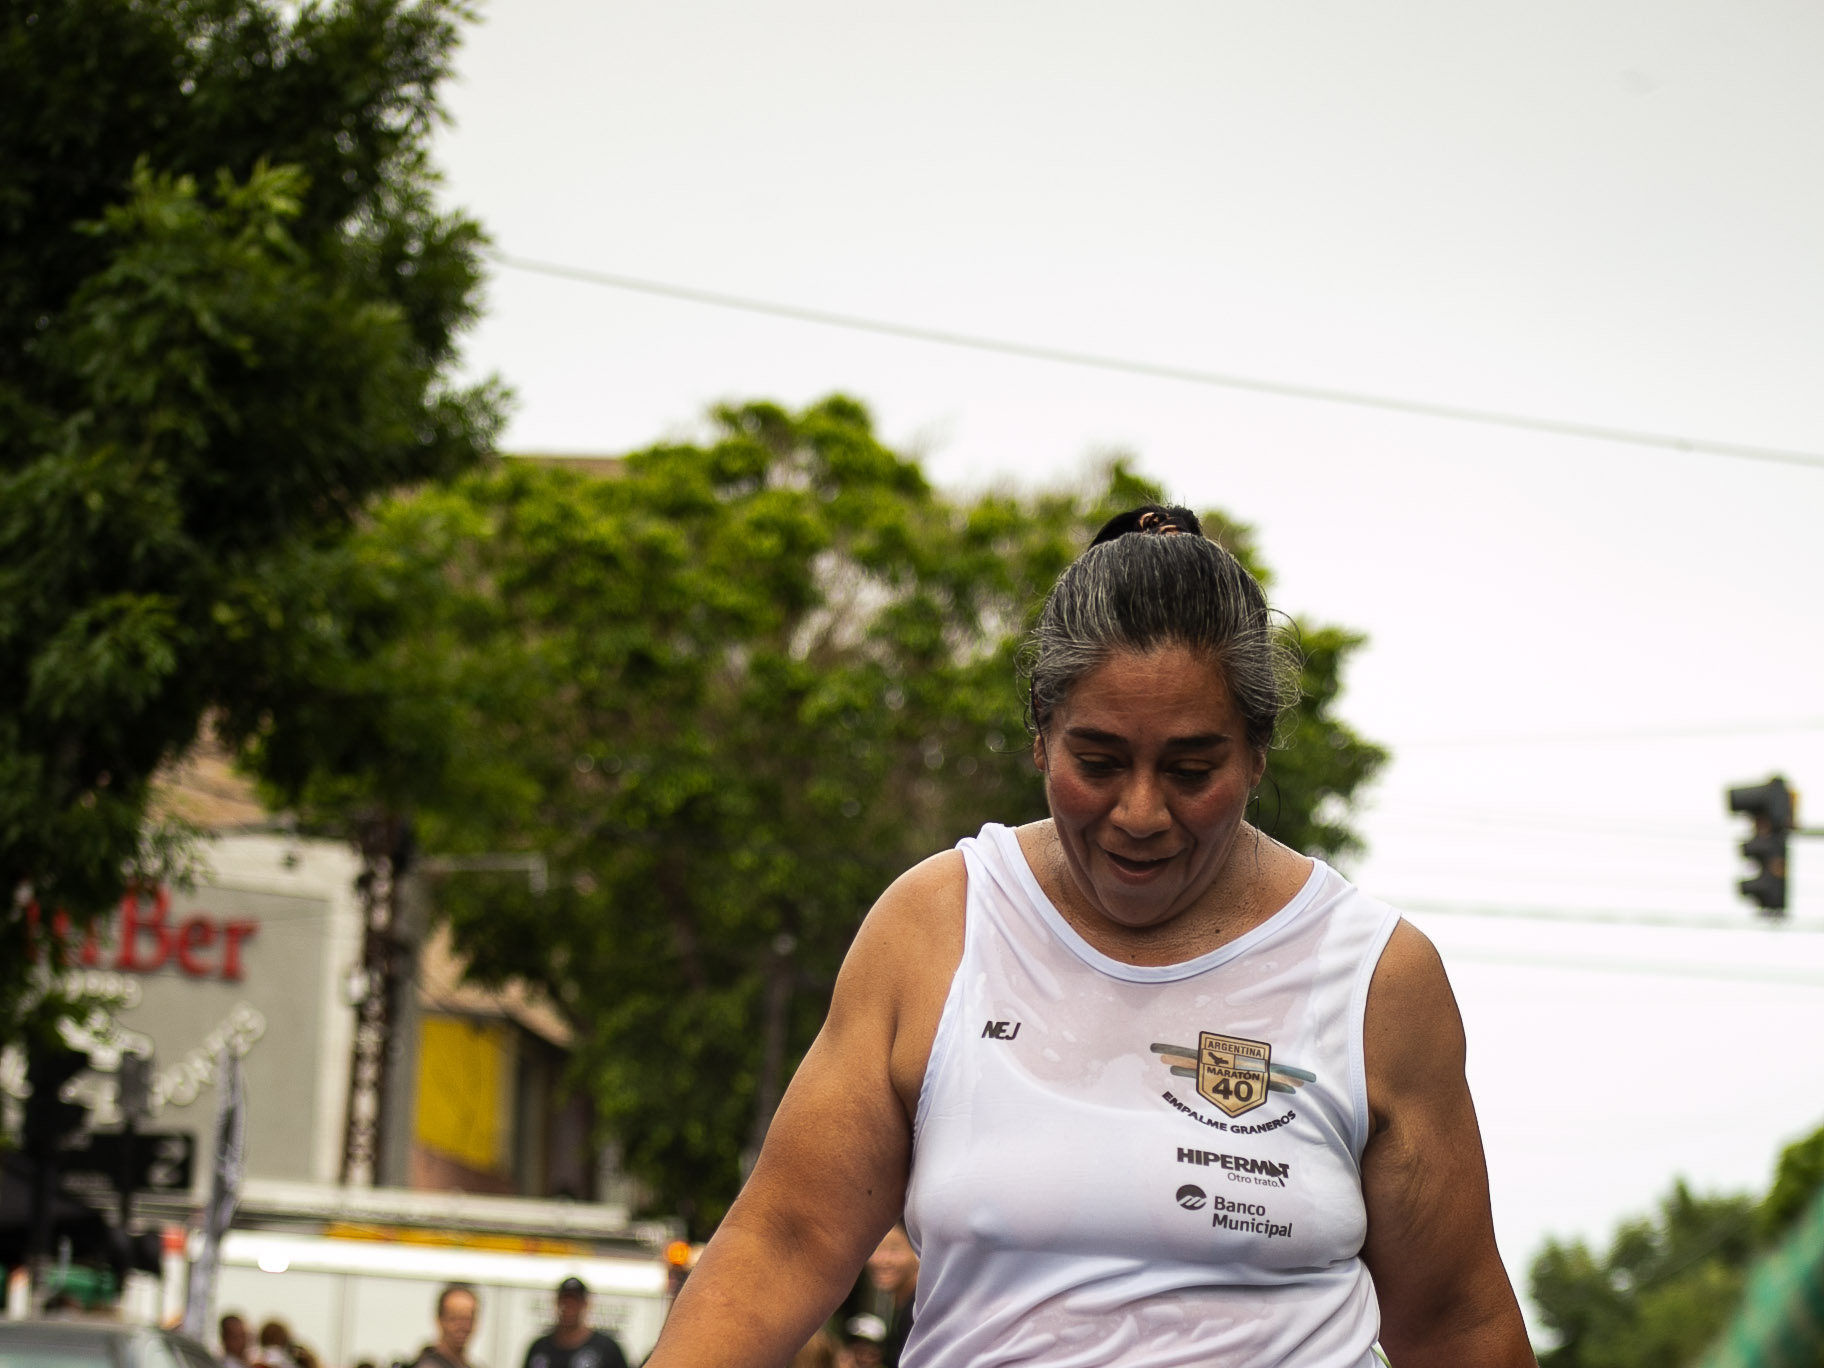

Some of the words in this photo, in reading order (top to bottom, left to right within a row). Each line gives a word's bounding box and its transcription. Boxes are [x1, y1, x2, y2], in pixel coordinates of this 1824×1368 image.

[981, 1020, 1021, 1040] NEJ
[1207, 1040, 1262, 1058] ARGENTINA
[1212, 1078, 1254, 1102] 40
[1162, 1091, 1228, 1132] EMPALME
[1230, 1109, 1297, 1135] GRANEROS
[1227, 1172, 1252, 1184] Otro
[1214, 1195, 1266, 1217] Banco
[1212, 1213, 1293, 1239] Municipal
